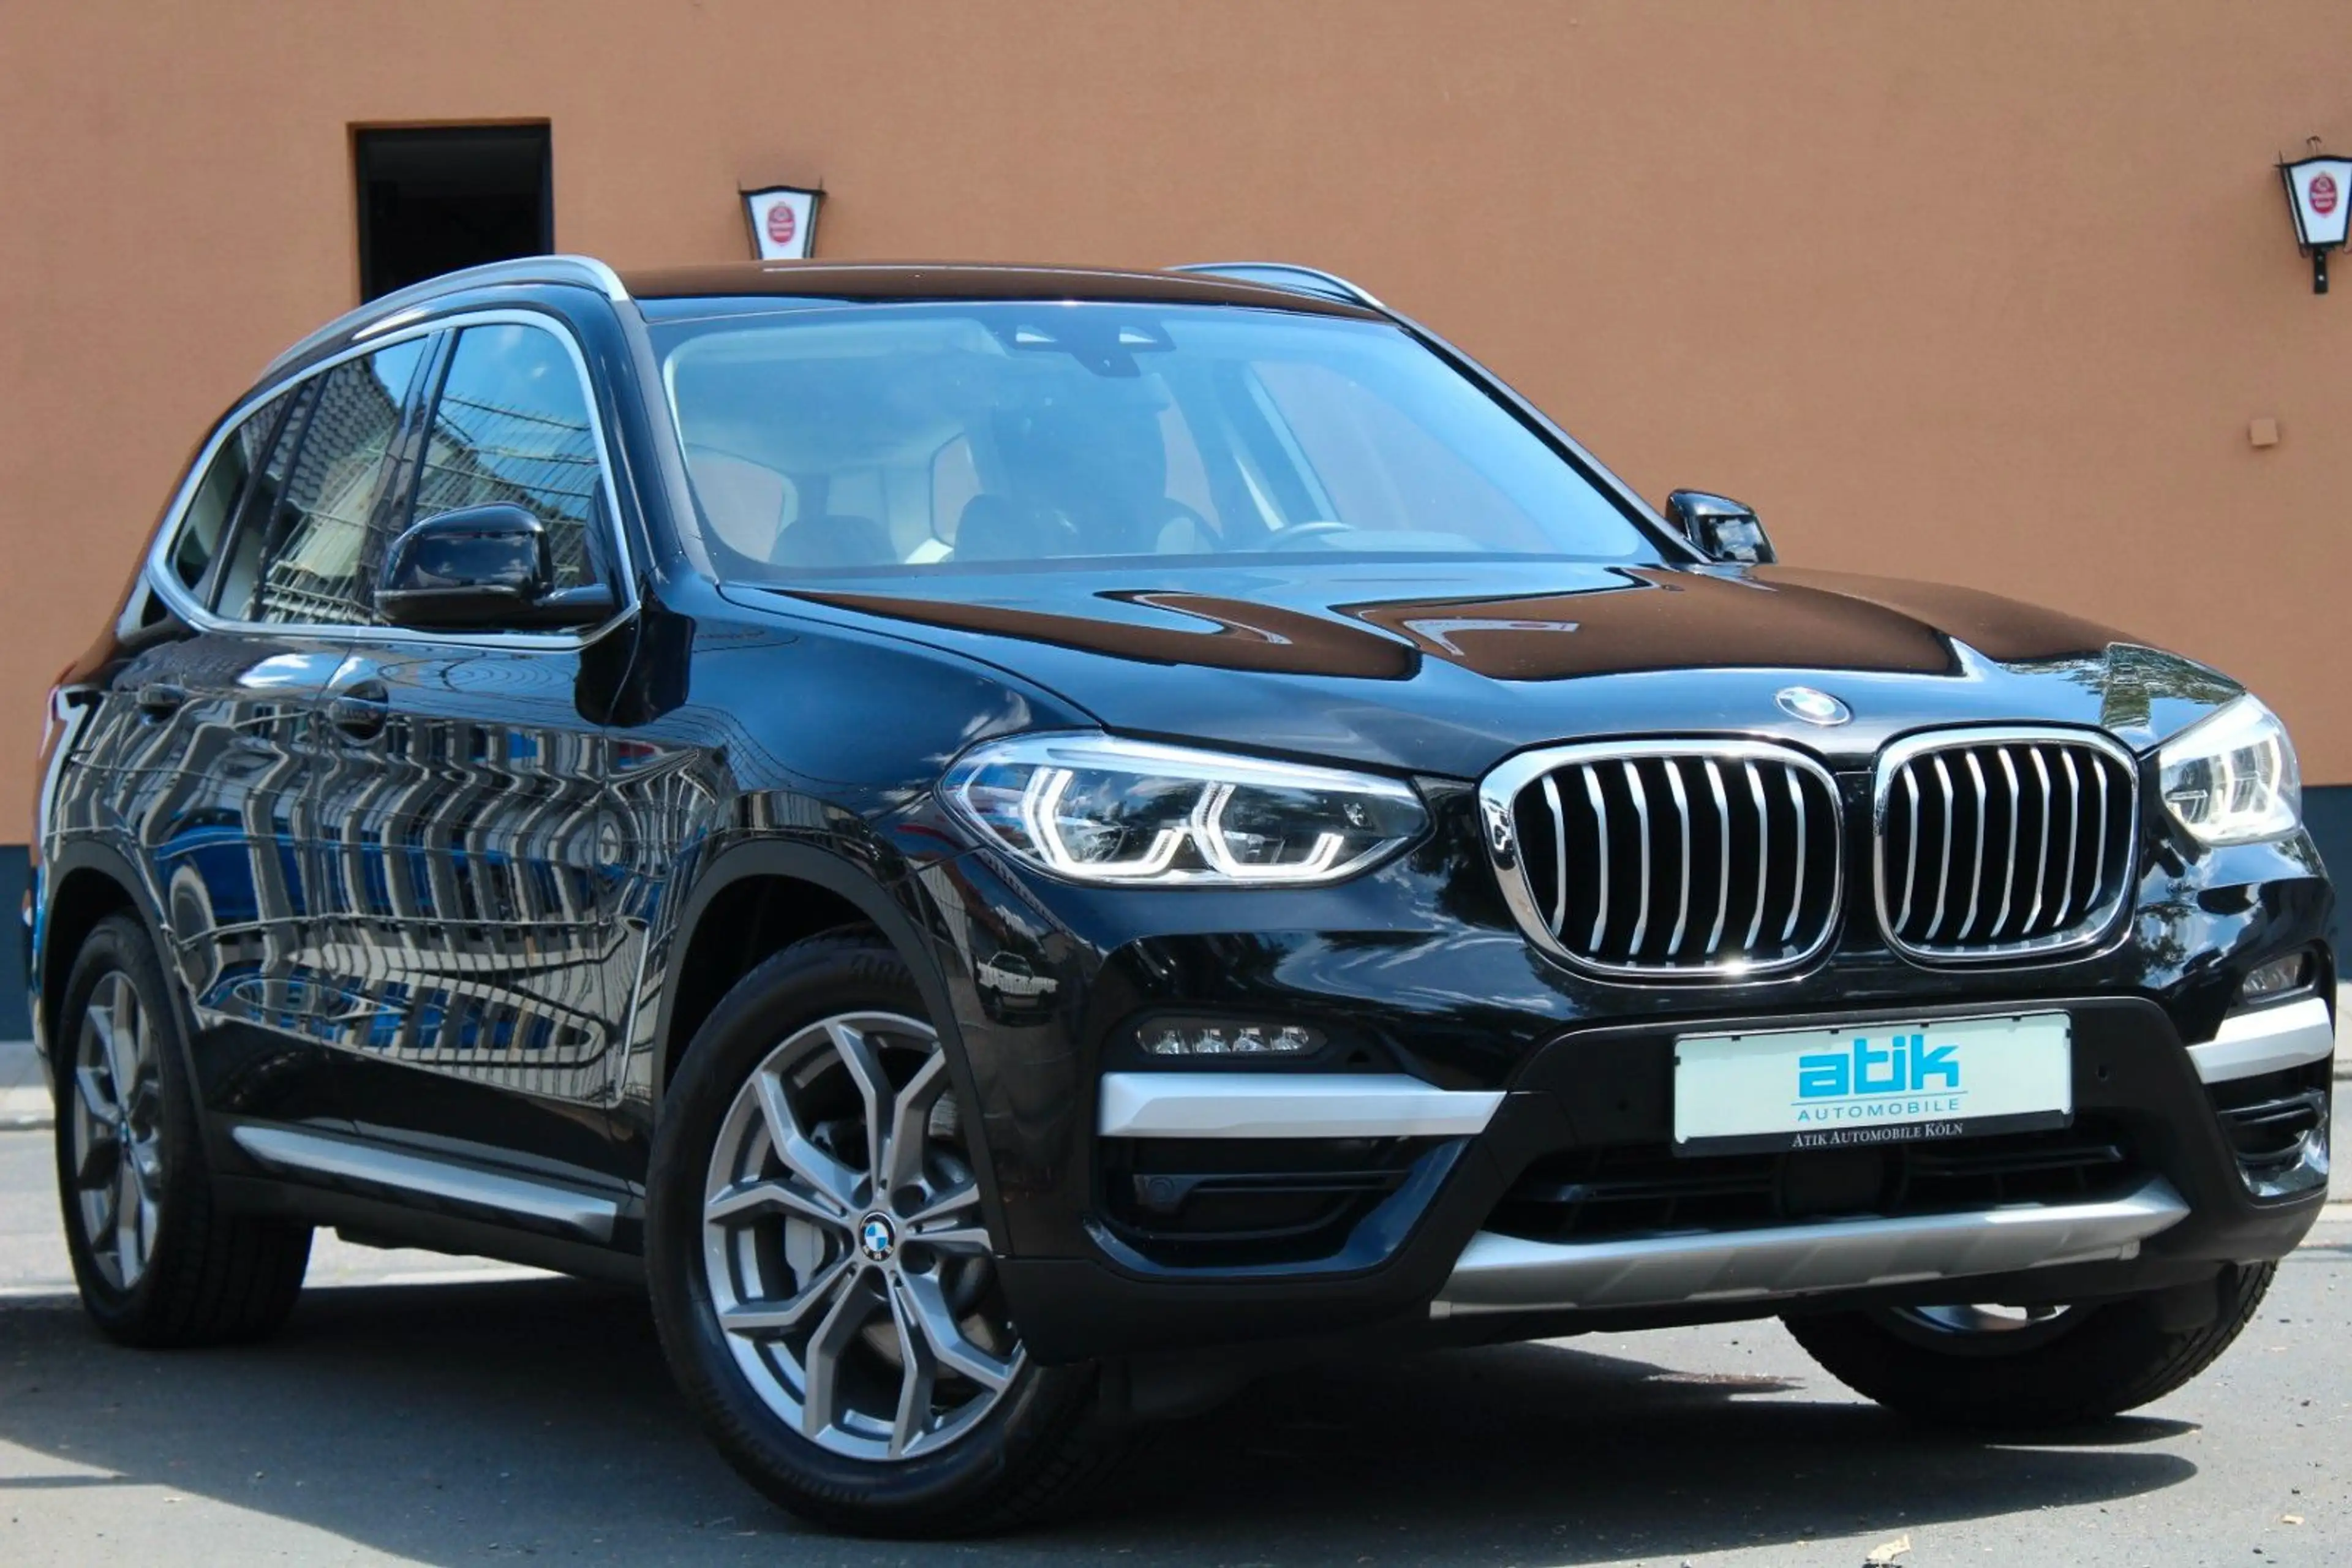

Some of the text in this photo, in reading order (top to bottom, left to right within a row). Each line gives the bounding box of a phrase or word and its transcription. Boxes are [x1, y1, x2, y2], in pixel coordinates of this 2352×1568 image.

[1798, 1098, 1959, 1122] AUTOMOBILE
[1830, 1126, 1921, 1144] AUTOMOBILE
[1924, 1121, 1964, 1137] KÖLN
